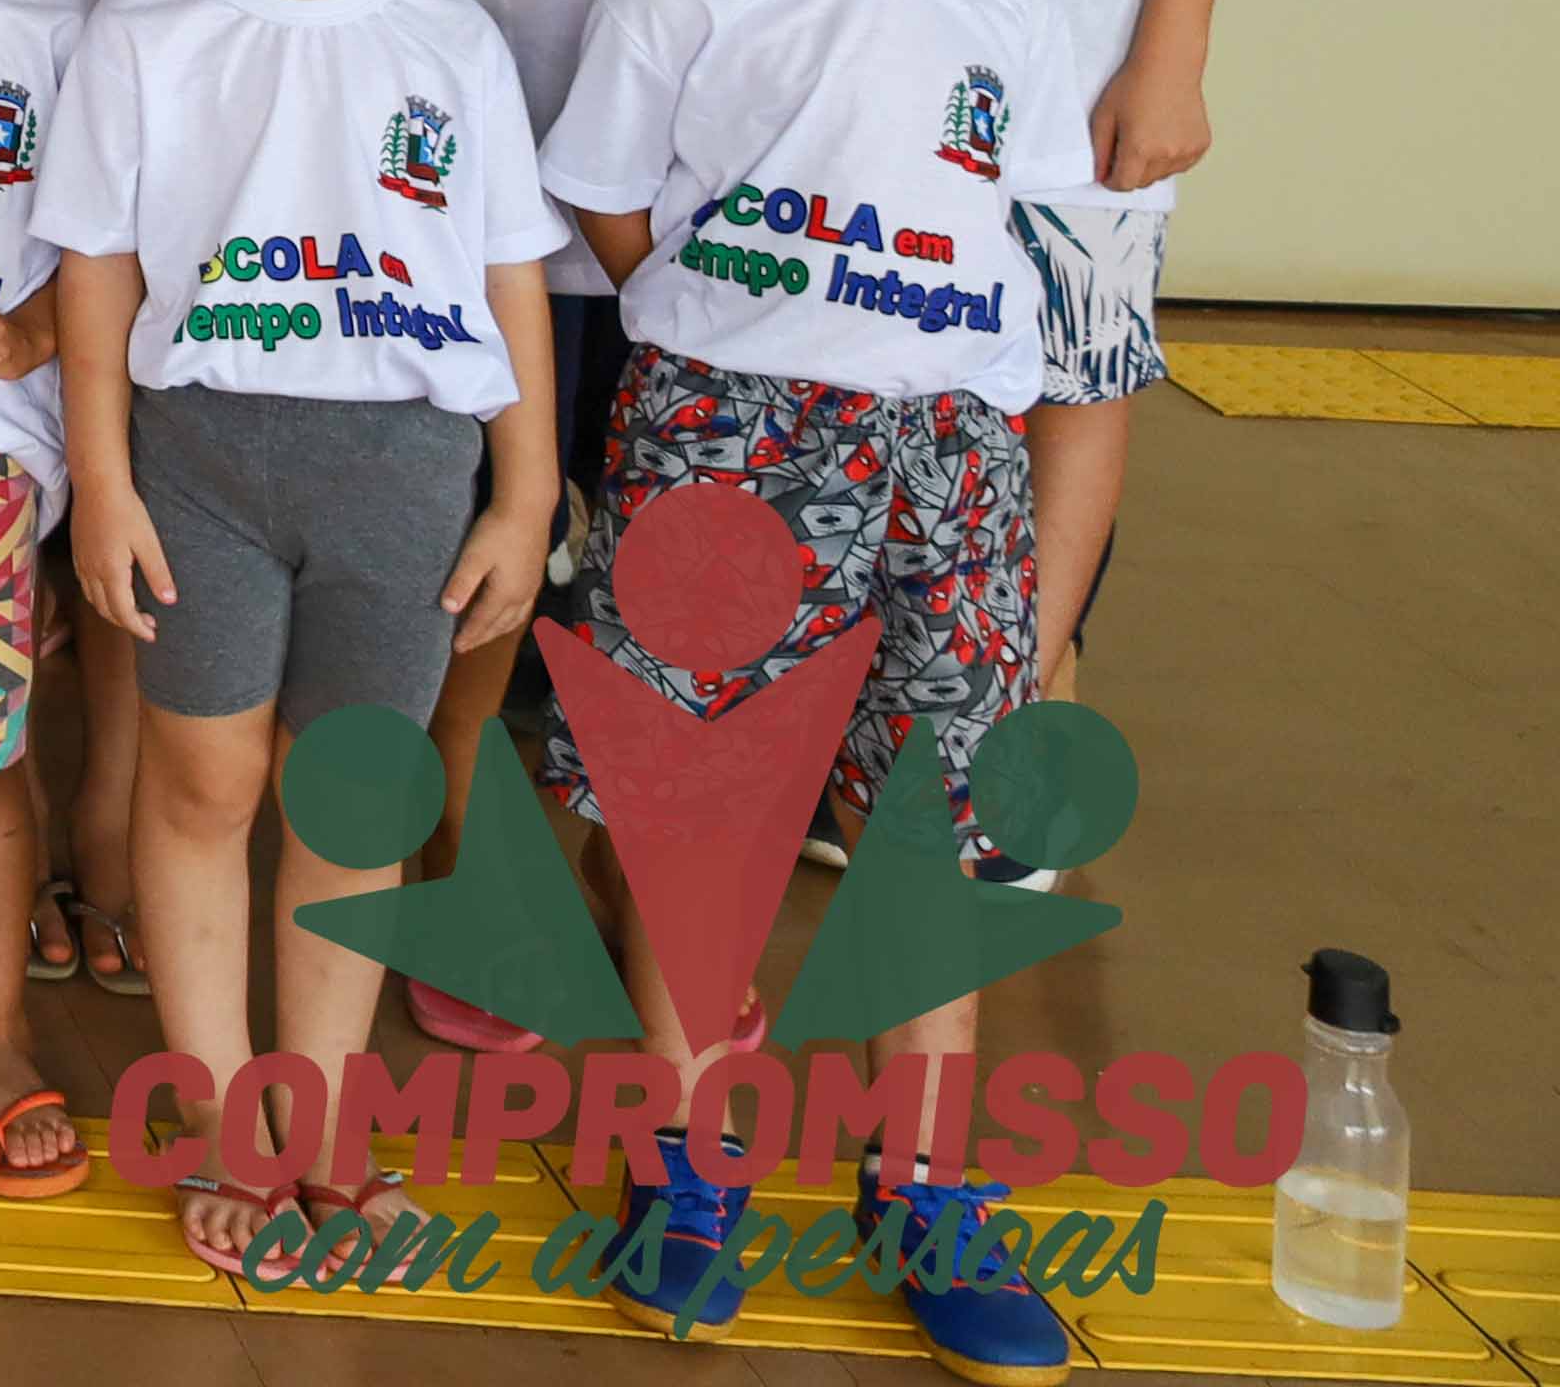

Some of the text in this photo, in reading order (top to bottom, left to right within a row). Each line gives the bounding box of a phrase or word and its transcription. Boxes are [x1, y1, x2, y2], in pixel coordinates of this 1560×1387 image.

[893, 227, 954, 266] em
[670, 232, 1006, 337] empo Integral
